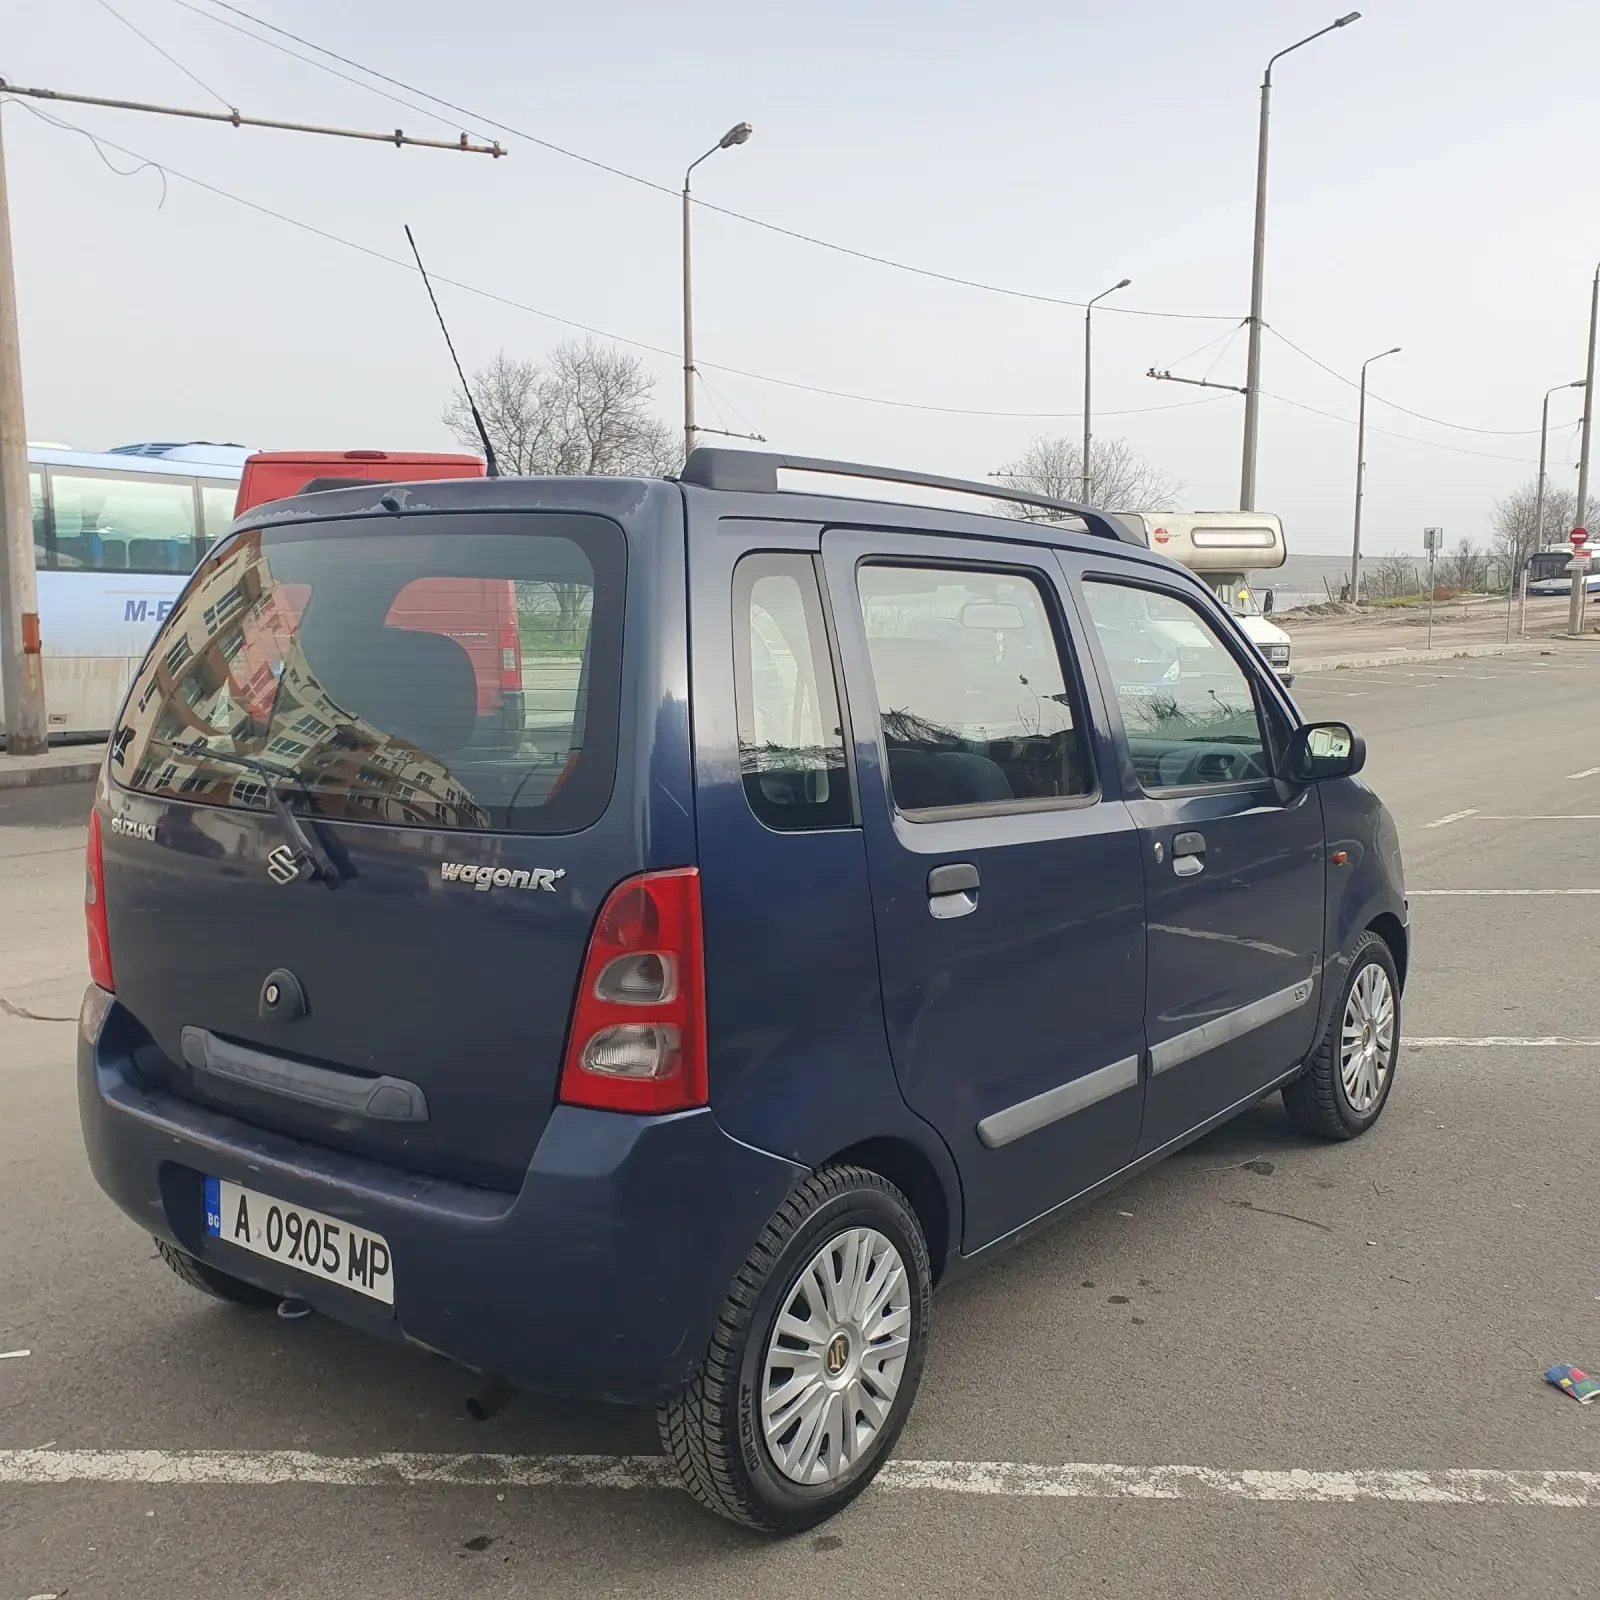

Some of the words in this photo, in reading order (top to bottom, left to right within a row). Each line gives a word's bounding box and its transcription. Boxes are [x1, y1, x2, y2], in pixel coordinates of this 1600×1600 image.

[112, 818, 156, 841] SUZUKI
[207, 1212, 220, 1228] BG
[234, 1194, 250, 1243] A
[267, 1206, 340, 1273] 0905
[348, 1232, 389, 1289] MP
[741, 1384, 760, 1472] DIPLOMAT
